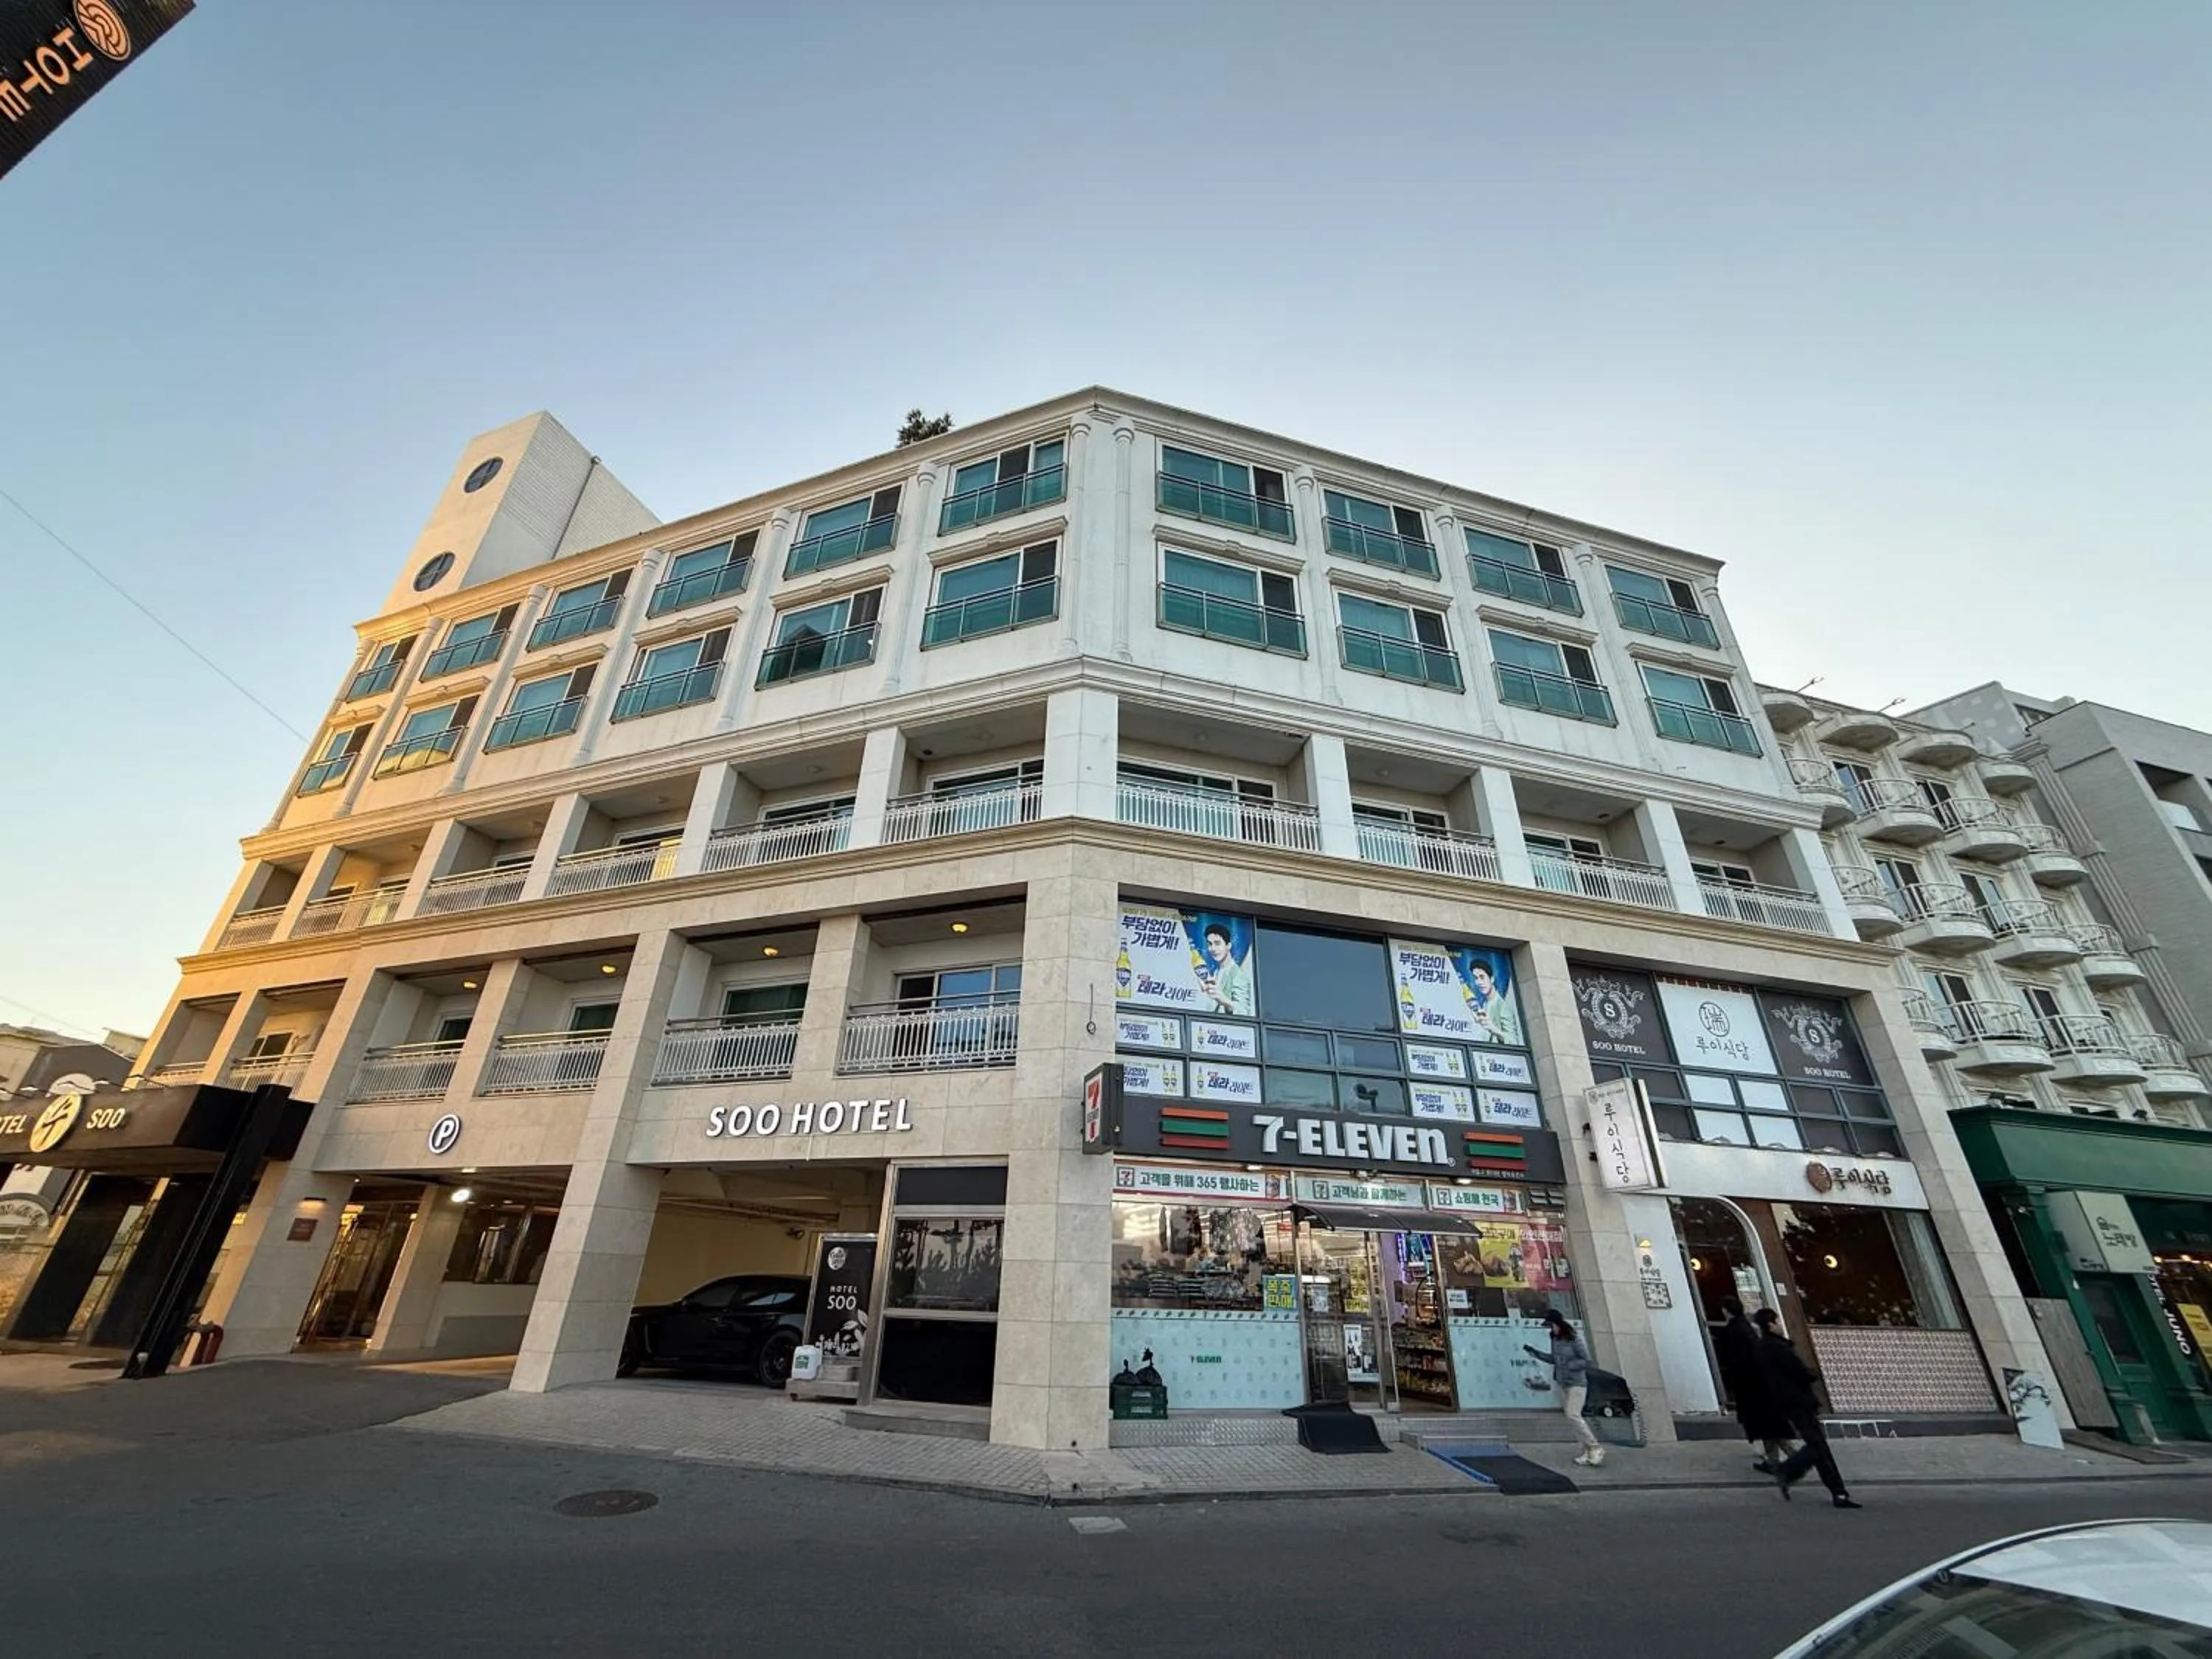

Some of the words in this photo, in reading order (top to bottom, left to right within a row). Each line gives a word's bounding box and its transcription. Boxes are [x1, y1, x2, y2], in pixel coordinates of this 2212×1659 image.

[1121, 915, 1177, 935] 부담없이
[1131, 931, 1180, 950] 가볍게!
[1399, 952, 1446, 970] 부담없이
[1409, 967, 1450, 985] 가볍게!
[1136, 978, 1166, 996] 테라
[1593, 1040, 1613, 1051] SOO
[1614, 1043, 1646, 1054] HOTEL
[1696, 1036, 1750, 1061] 루이식당
[0, 1115, 27, 1134] TEL
[86, 1108, 125, 1129] SOO
[706, 1104, 782, 1138] SOO
[790, 1098, 914, 1135] HOTEL
[435, 1119, 455, 1147] P
[1604, 1102, 1630, 1183] 루이식당
[1140, 1172, 1172, 1186] 고객을
[1174, 1173, 1194, 1188] 위해
[1197, 1176, 1217, 1189] 365
[1220, 1177, 1259, 1192] 행사하는
[1830, 1167, 1892, 1194] 루이식당
[1332, 1185, 1369, 1200] 고객님과
[830, 1285, 858, 1294] HOTEL
[827, 1295, 857, 1310] SOO
[2163, 1308, 2191, 1355] JUNO
